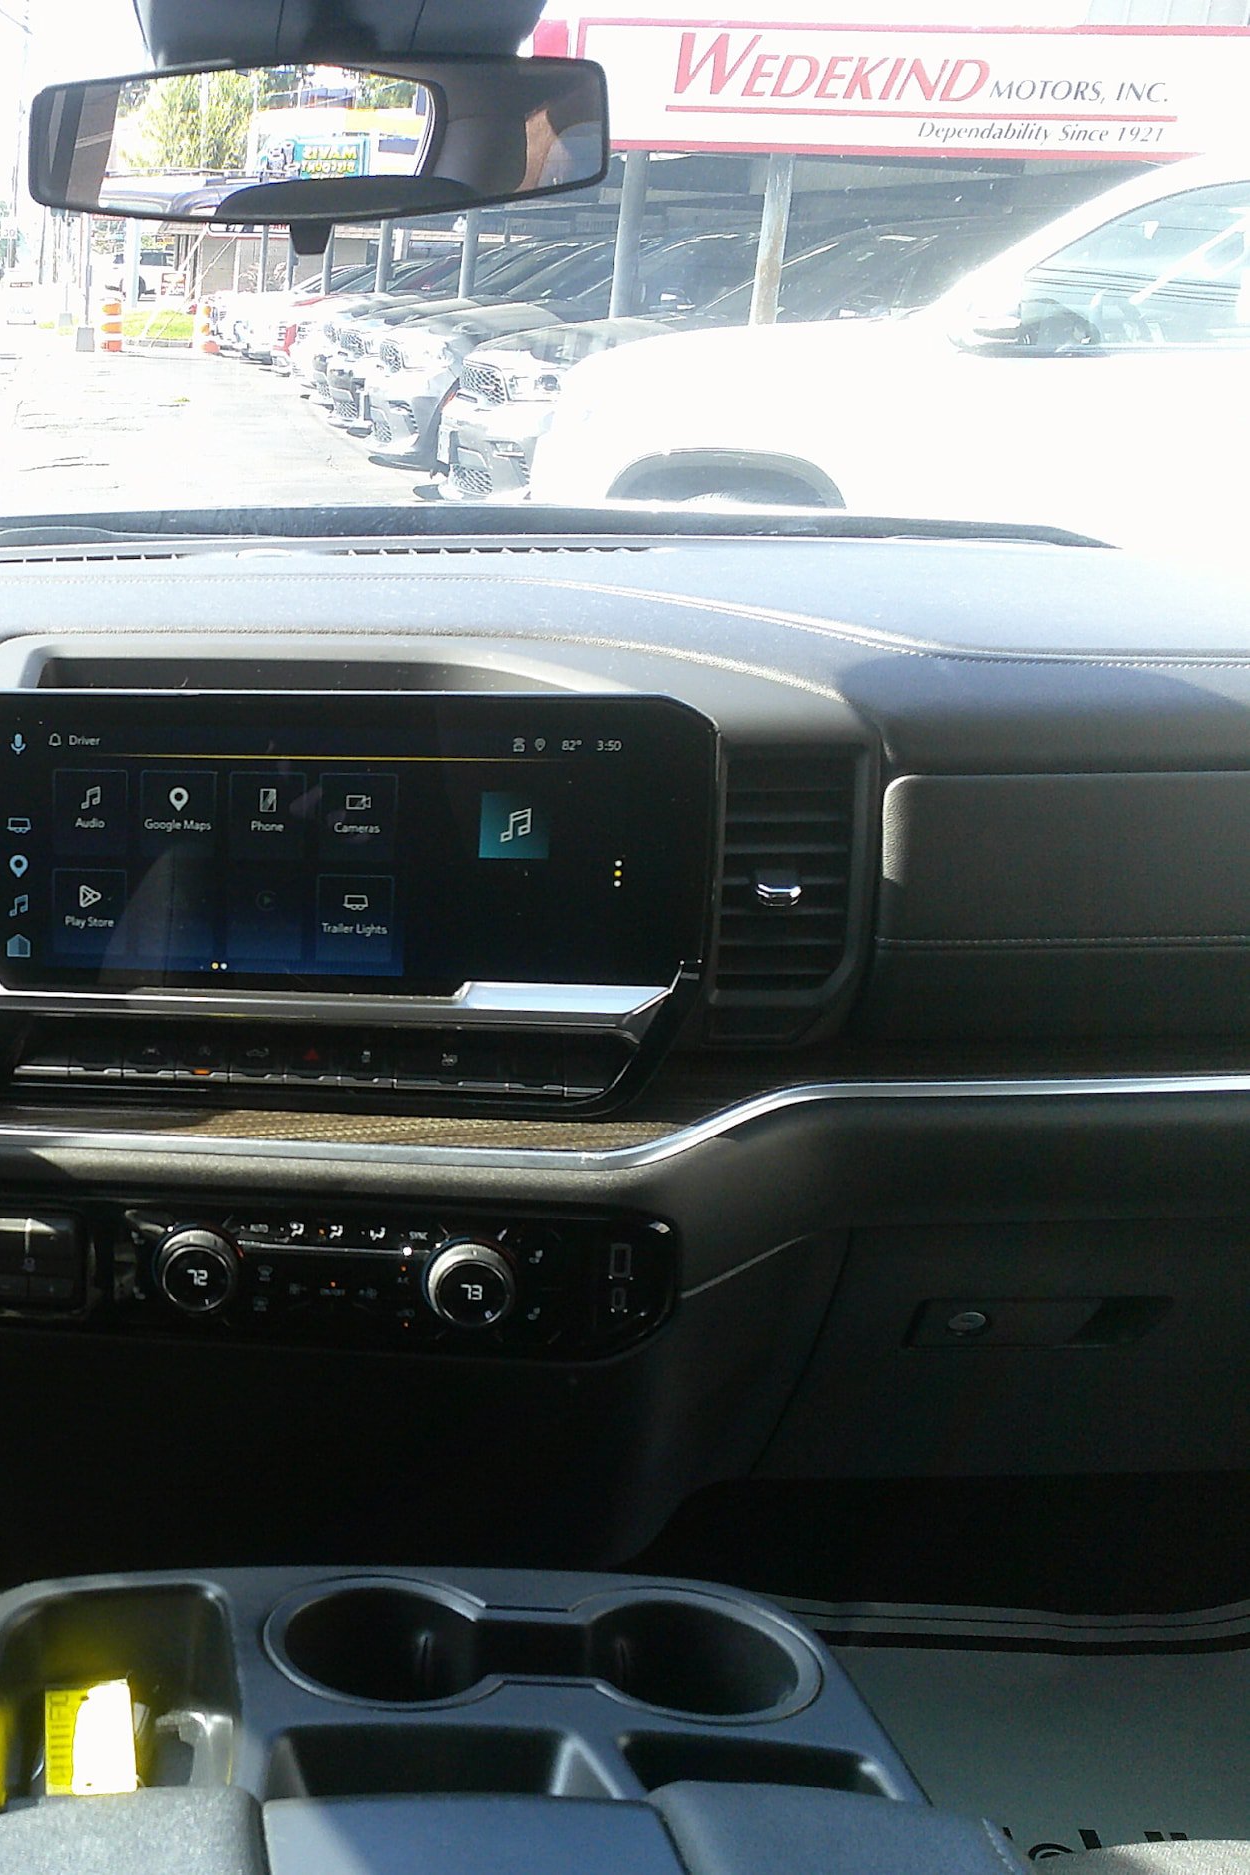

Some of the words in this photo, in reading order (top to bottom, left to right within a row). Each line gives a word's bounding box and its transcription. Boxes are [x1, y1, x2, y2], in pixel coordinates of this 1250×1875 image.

[673, 32, 990, 102] WEDEKIND
[989, 80, 1105, 104] MOTORS,
[1116, 82, 1168, 102] INC.
[917, 121, 1052, 145] Dependability
[1058, 124, 1109, 142] Since
[1118, 126, 1165, 142] 1921
[68, 735, 101, 746] Driver
[597, 740, 622, 751] 3:50
[75, 817, 106, 829] Audio
[144, 818, 182, 832] Google
[184, 819, 212, 832] Maps
[251, 820, 285, 832] Phone
[334, 822, 381, 834] Cameras
[65, 915, 87, 929] Play
[88, 916, 115, 928] Store
[321, 922, 353, 934] Trailer
[356, 924, 388, 937] Lights
[409, 1231, 428, 1241] SYNC
[187, 1269, 208, 1286] 72
[461, 1284, 483, 1300] 73
